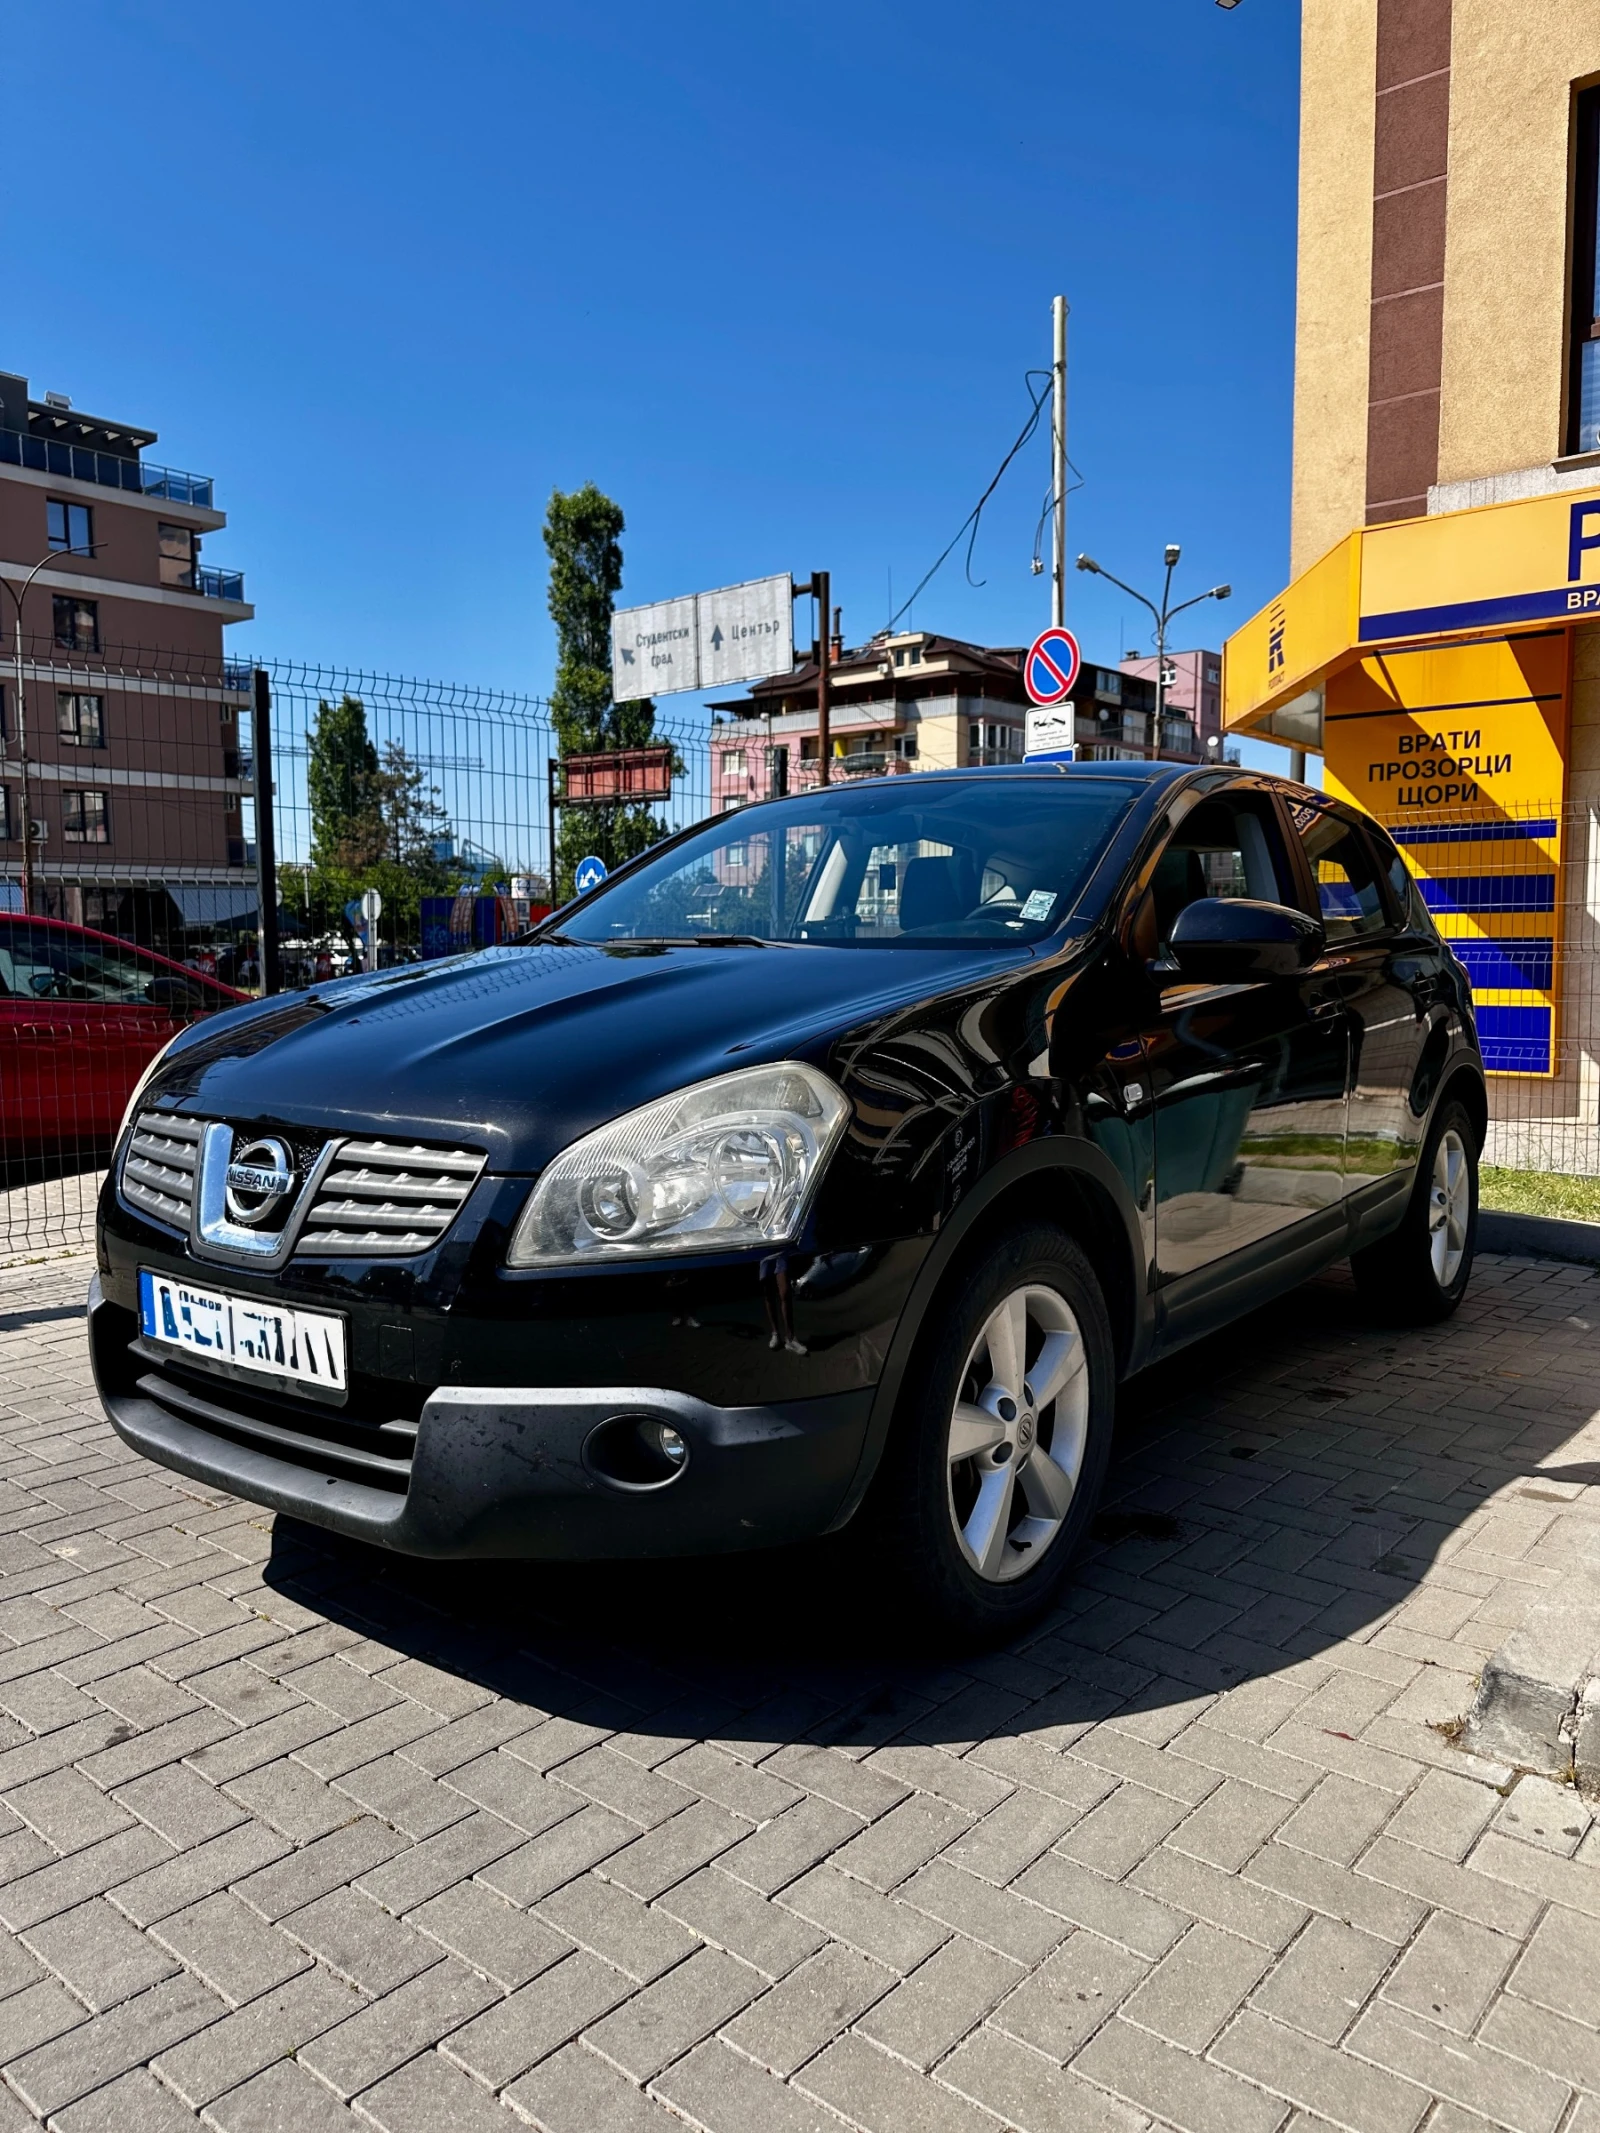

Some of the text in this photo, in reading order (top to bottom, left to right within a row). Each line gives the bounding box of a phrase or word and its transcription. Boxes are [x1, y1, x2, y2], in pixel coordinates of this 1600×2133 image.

[636, 627, 690, 648] Студентски
[731, 620, 780, 640] Център
[651, 653, 673, 669] град
[1398, 730, 1481, 754] ВРАТИ
[1368, 754, 1511, 782] ПРОЗОРЦИ
[1398, 783, 1478, 808] ЩОРИ
[227, 1166, 276, 1188] NISSAN
